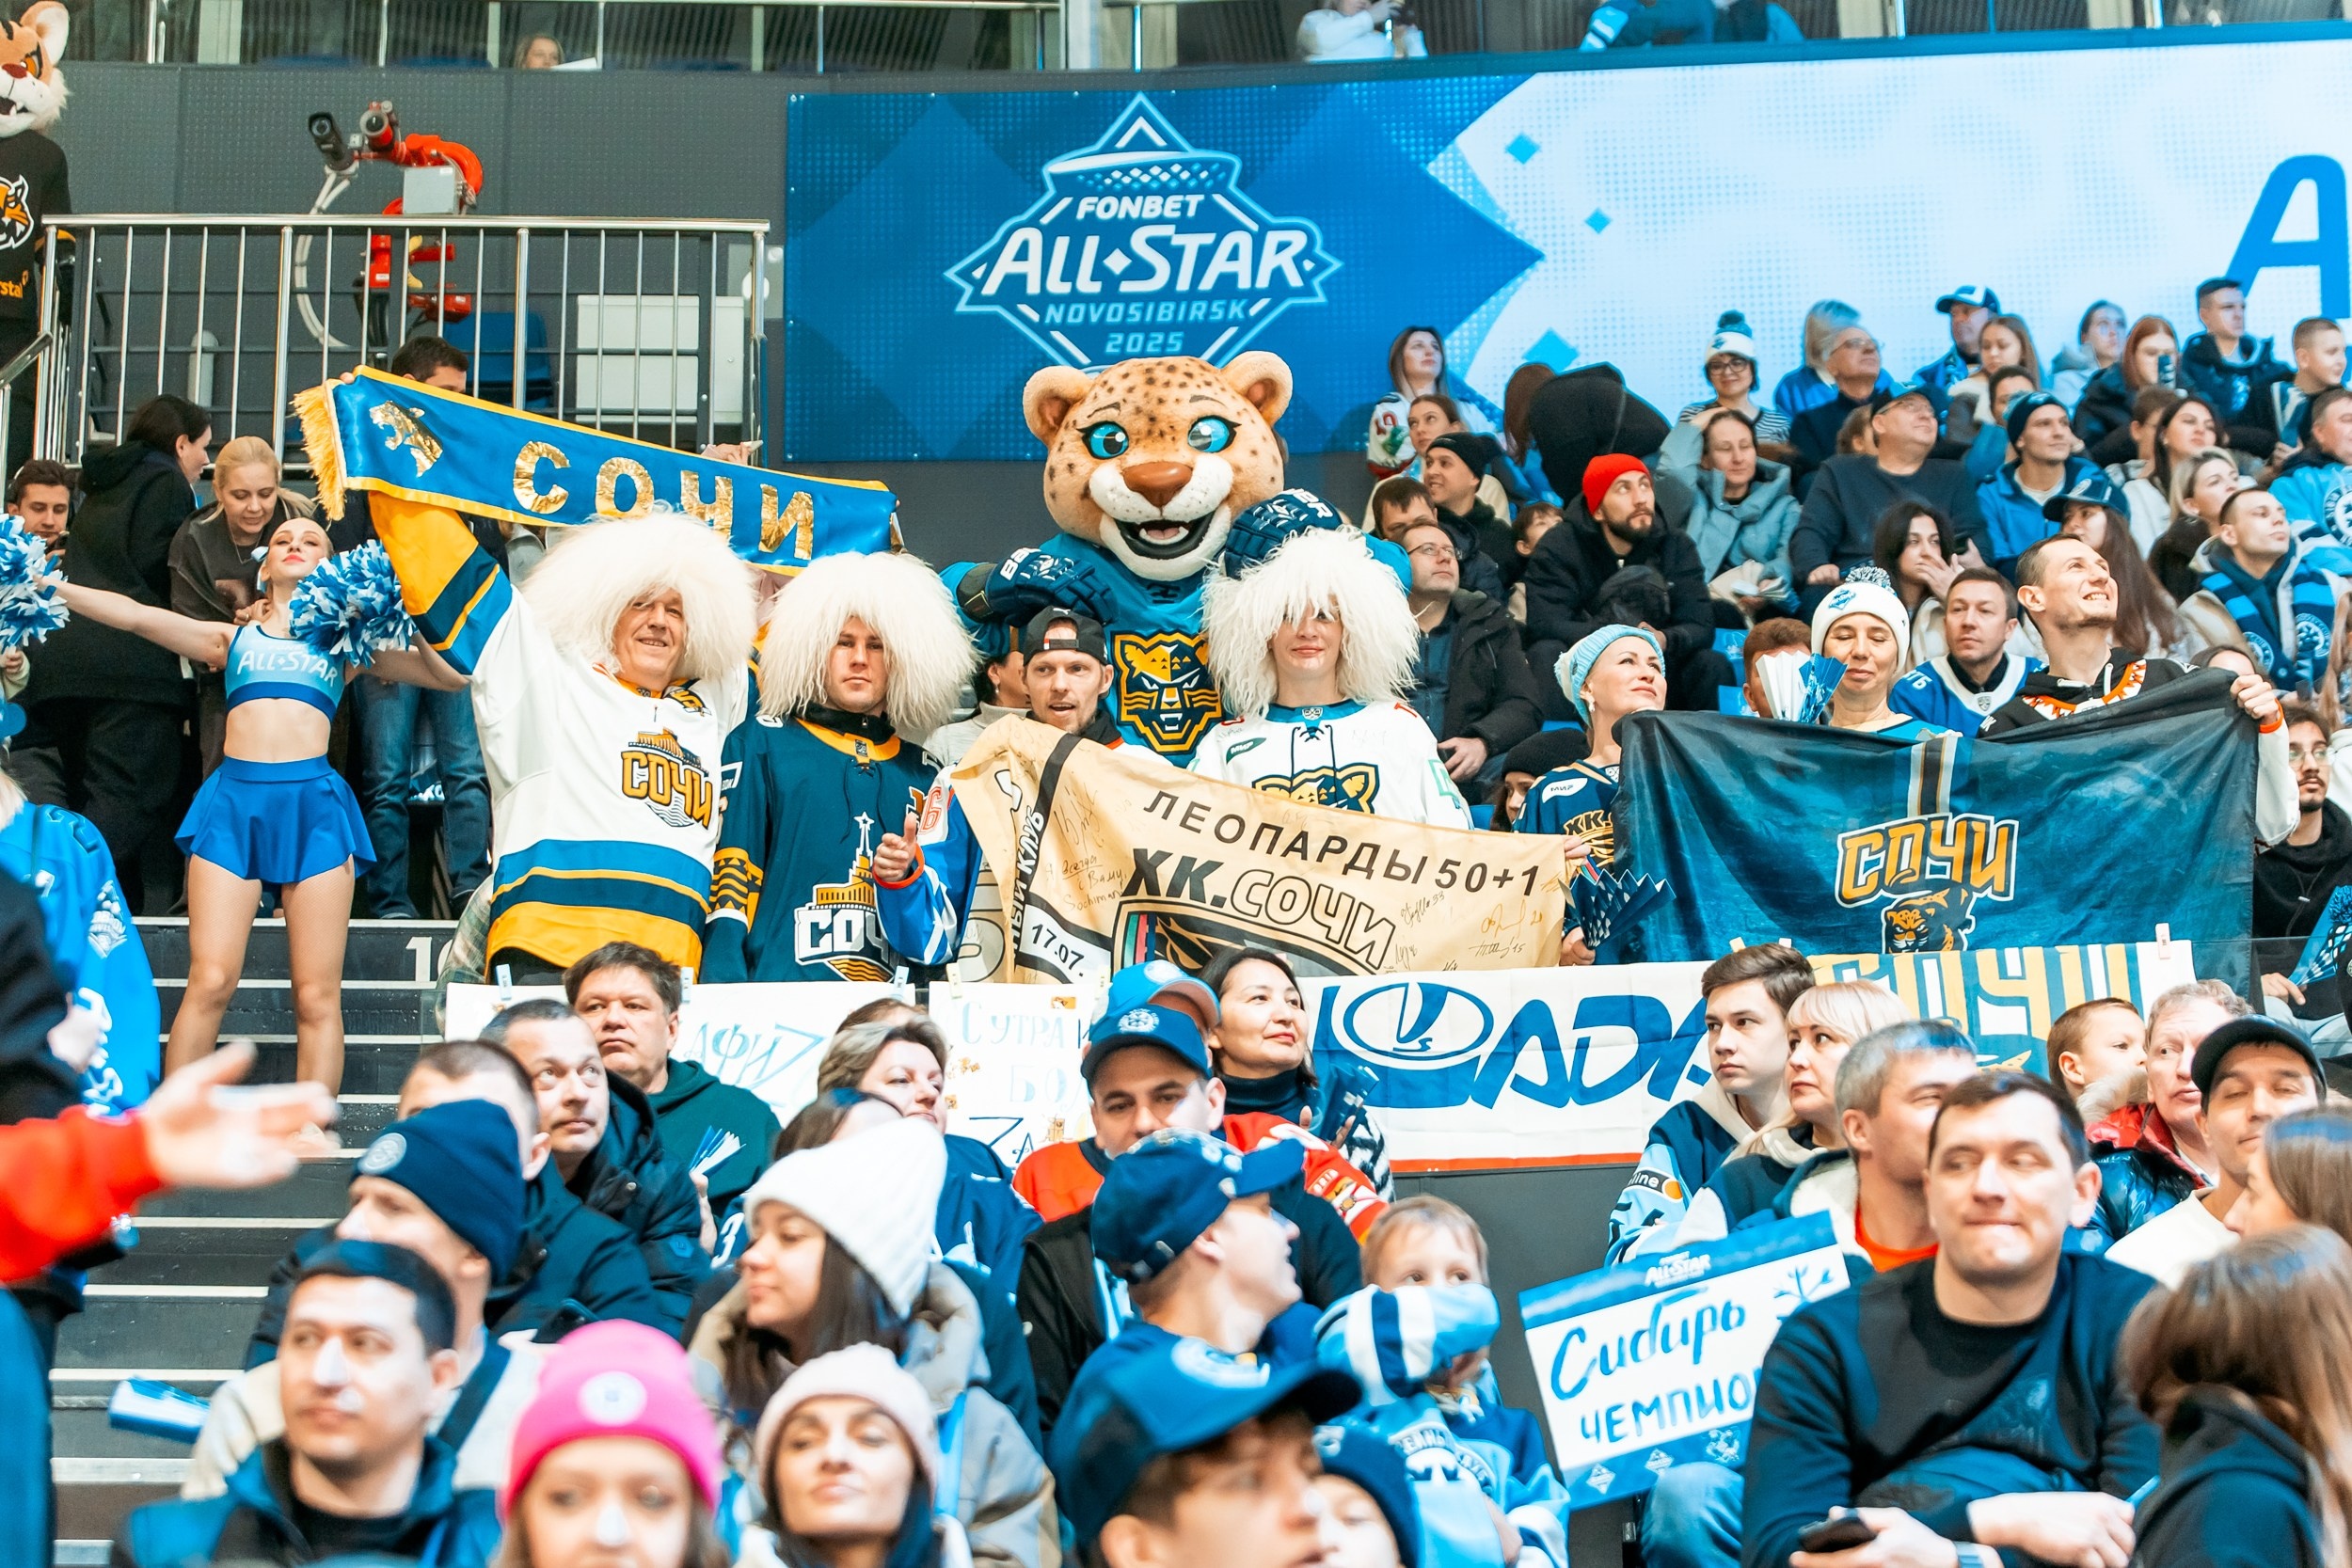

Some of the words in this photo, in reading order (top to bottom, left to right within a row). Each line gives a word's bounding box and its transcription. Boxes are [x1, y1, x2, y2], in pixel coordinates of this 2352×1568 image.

[1075, 194, 1205, 220] FONBET
[1043, 298, 1250, 325] NOVOSIBIRSK
[1104, 331, 1185, 355] 2025
[513, 439, 815, 562] СОЧИ
[620, 751, 713, 830] СОЧИ
[1143, 790, 1428, 887] ЛЕОПАРДЫ
[1435, 860, 1540, 897] 50+1
[1838, 816, 2015, 904] СОЧИ
[795, 909, 890, 961] СОЧ
[1551, 1286, 1746, 1402] Сибирь
[1581, 1367, 1762, 1443] ЧЕМПИО
